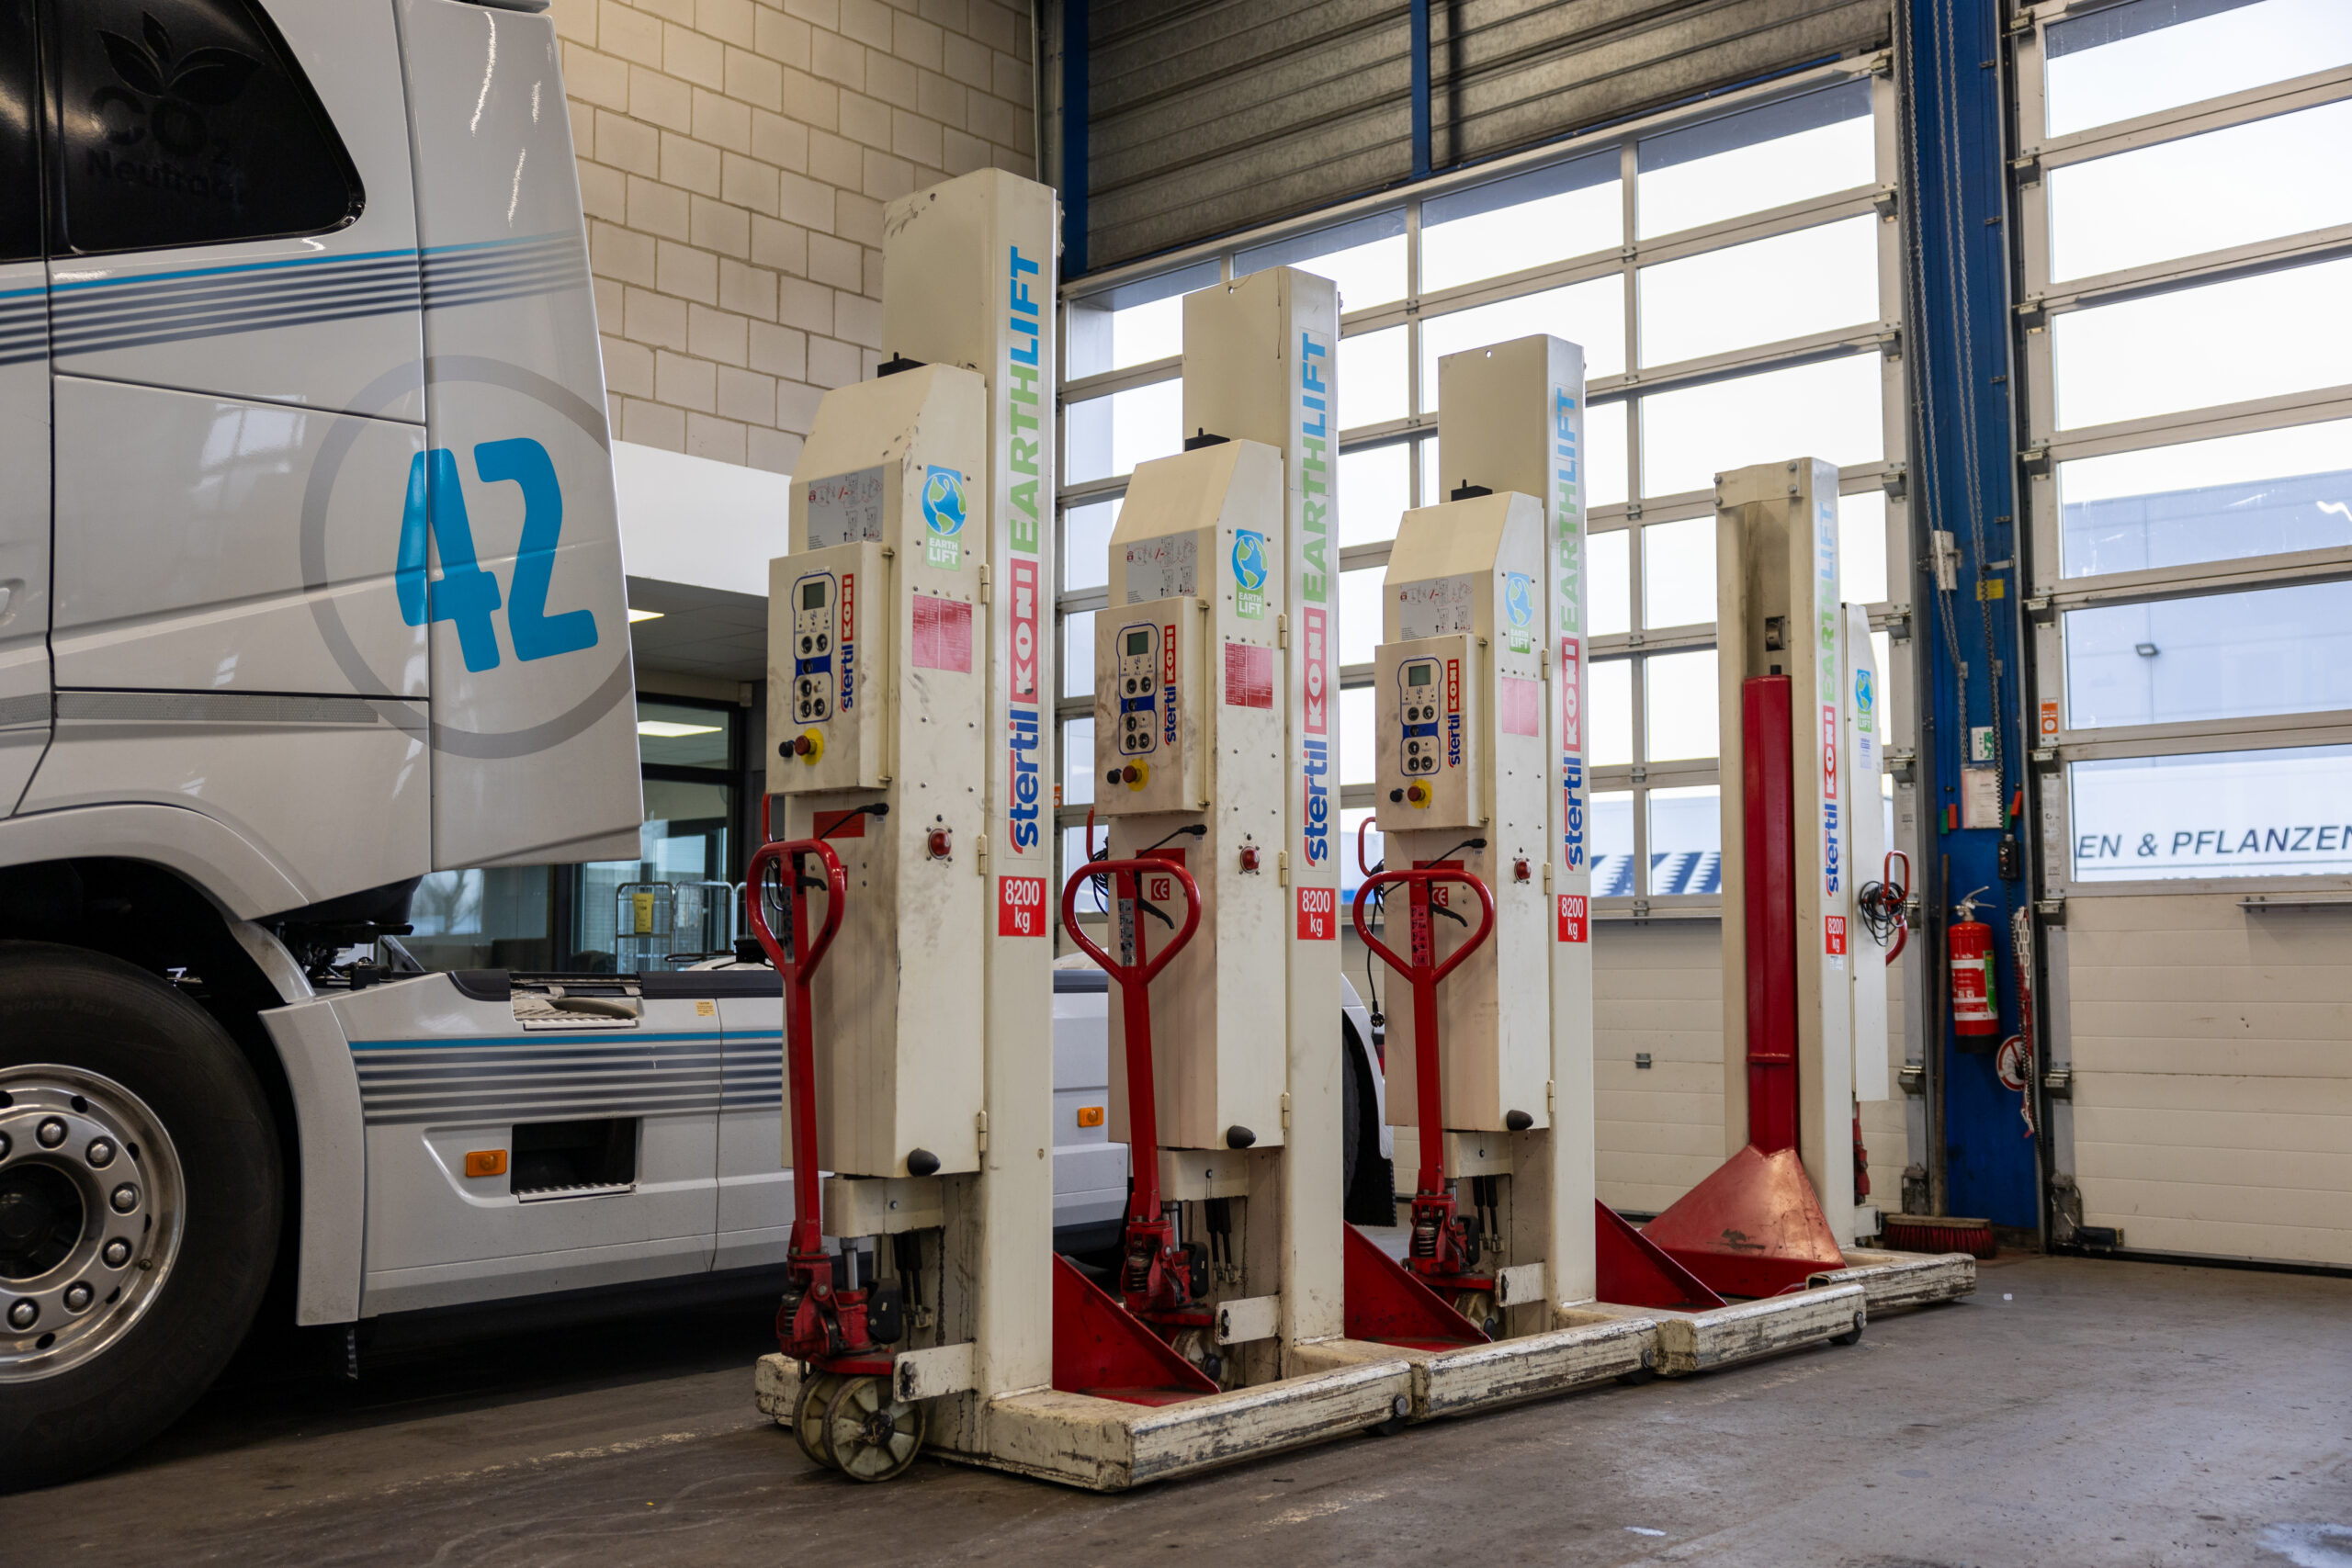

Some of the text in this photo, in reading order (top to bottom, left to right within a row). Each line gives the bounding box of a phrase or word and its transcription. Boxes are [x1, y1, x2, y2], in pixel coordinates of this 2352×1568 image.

[396, 437, 598, 672] 42
[929, 537, 958, 551] EARTH
[929, 547, 958, 565] LIFT
[1010, 245, 1039, 853] stertil KONI EARTHLIFT
[1238, 592, 1262, 604] EARTH
[1238, 600, 1262, 615] LIFT
[1302, 333, 1328, 866] stertil KONI EARTHLIFT
[841, 576, 854, 713] stertil KONI
[1510, 636, 1529, 649] LIFT
[1164, 626, 1176, 746] stertil KONI
[1564, 641, 1578, 749] KONI
[1448, 660, 1460, 768] stertil KONI
[1825, 708, 1835, 796] KONI
[1563, 757, 1583, 871] stertil
[1824, 804, 1838, 897] stertil
[2077, 834, 2121, 858] EN
[2137, 832, 2159, 857] &
[1004, 879, 1040, 907] 8200
[1153, 880, 1168, 898] CE
[1432, 888, 1446, 905] CE
[1302, 891, 1330, 913] 8200
[1561, 897, 1584, 918] 8200
[1013, 907, 1031, 933] kg
[1310, 915, 1324, 937] kg
[1567, 919, 1578, 940] kg
[1827, 918, 1844, 934] 8200
[1832, 934, 1840, 953] kg
